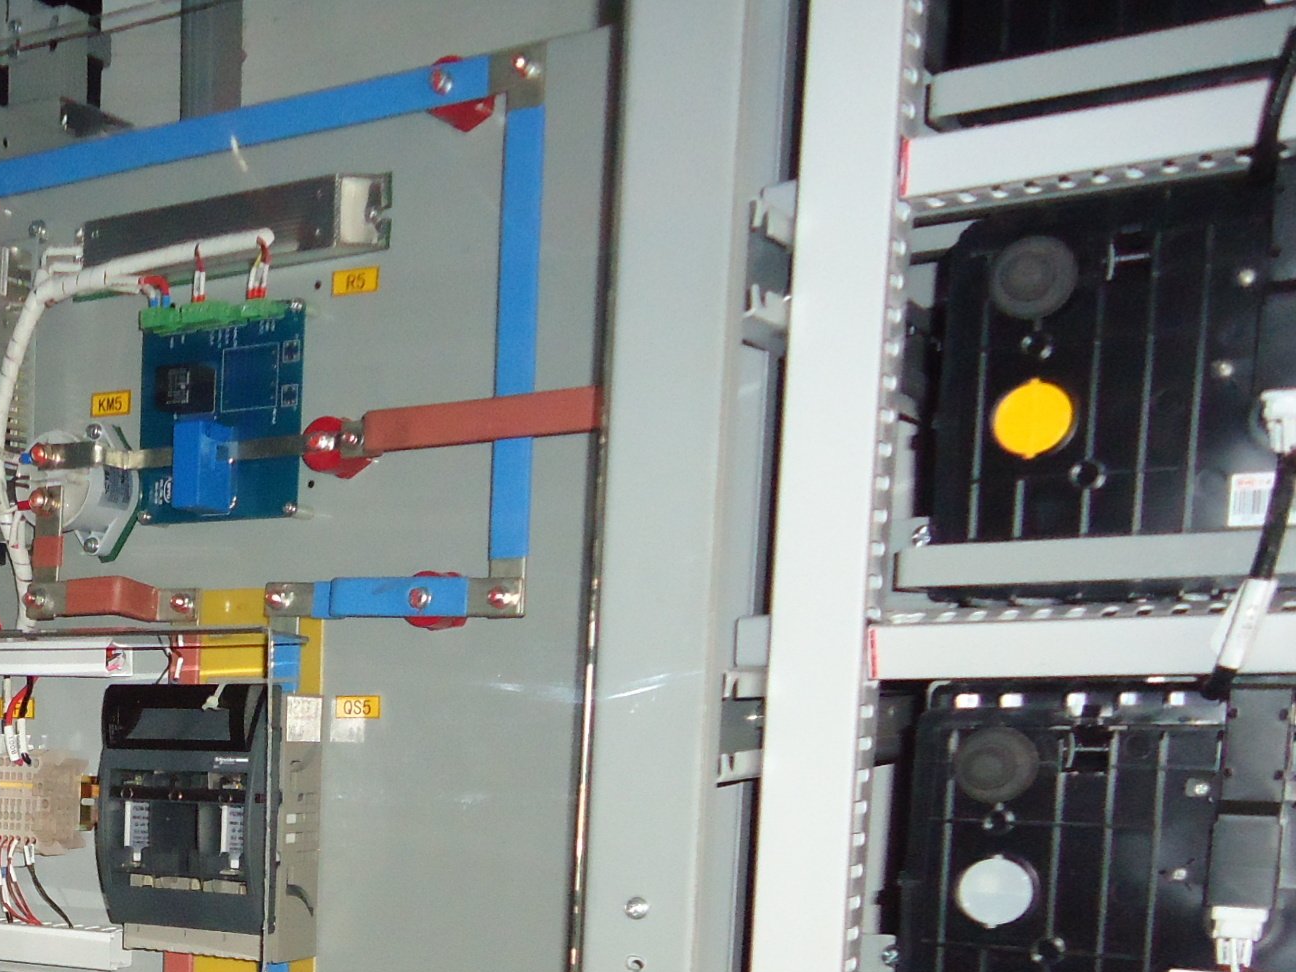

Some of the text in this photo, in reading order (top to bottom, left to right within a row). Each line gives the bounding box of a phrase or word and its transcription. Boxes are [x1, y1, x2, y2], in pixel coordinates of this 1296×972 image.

[346, 272, 366, 291] R5
[98, 395, 123, 412] KM5
[343, 700, 371, 715] QS5
